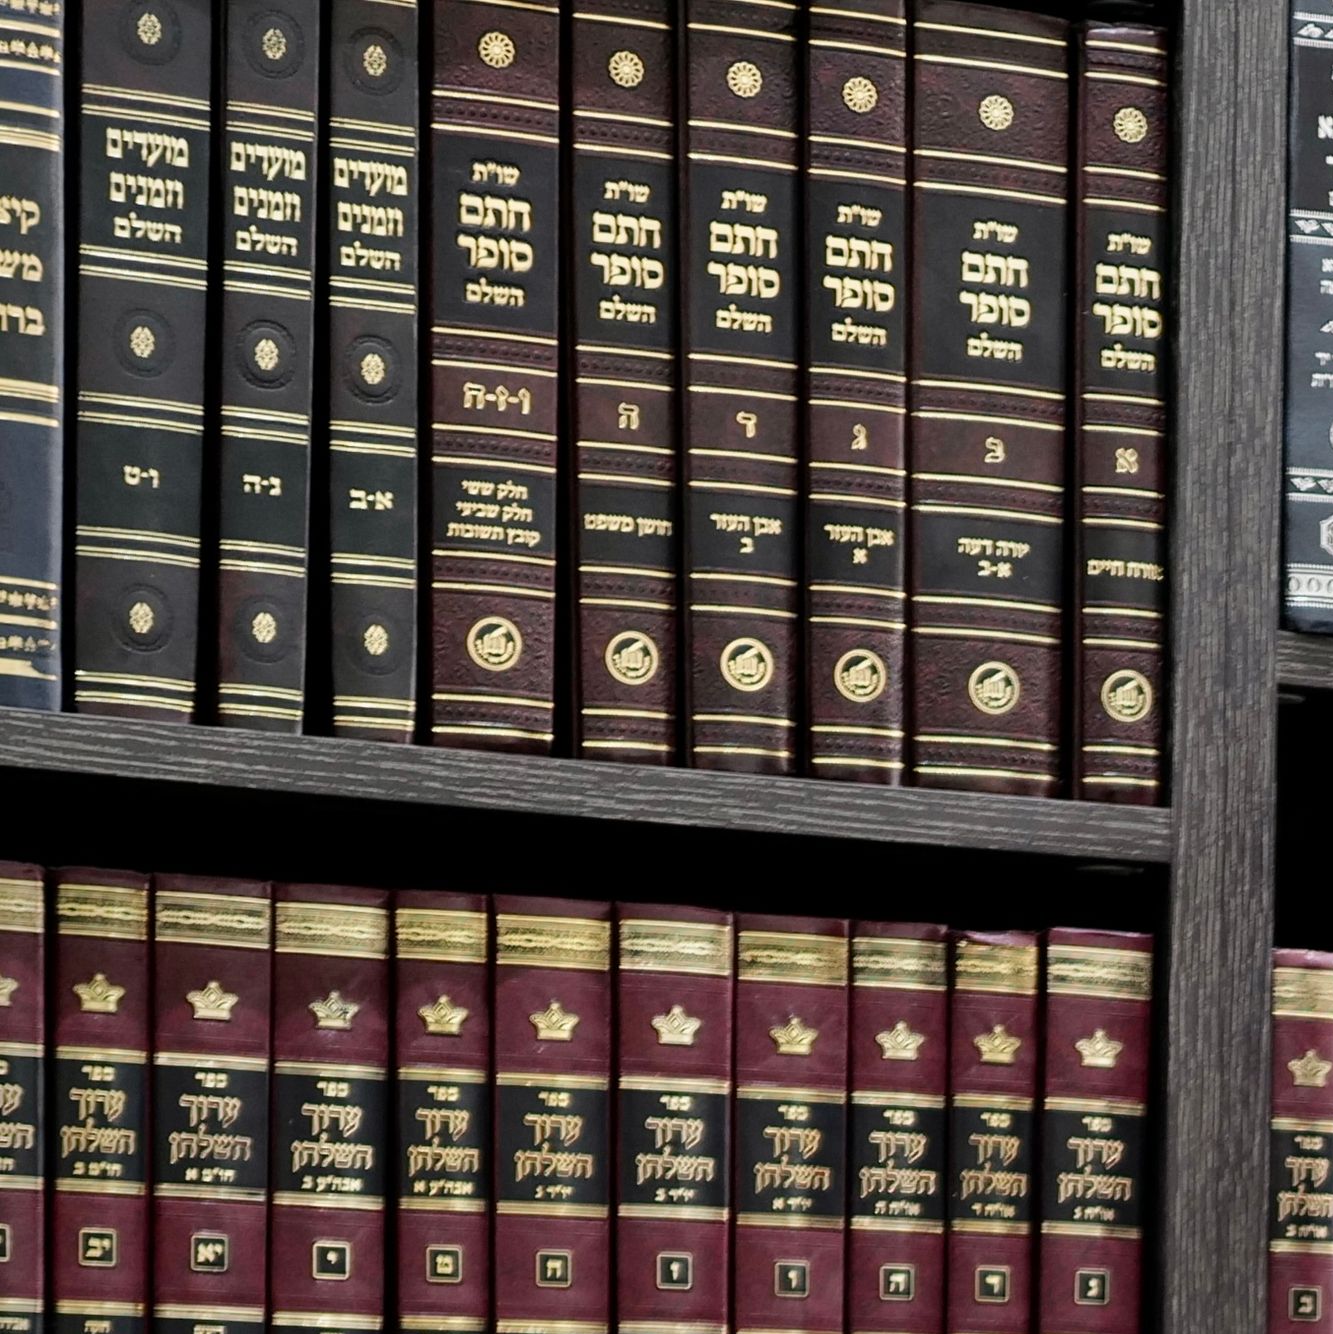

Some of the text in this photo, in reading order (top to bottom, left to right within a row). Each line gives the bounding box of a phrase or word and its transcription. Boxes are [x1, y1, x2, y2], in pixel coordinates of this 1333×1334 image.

[107, 128, 188, 167] מועדים
[231, 142, 305, 180] מועדים
[334, 158, 407, 196] מועדים
[473, 163, 519, 186] שו"ת
[605, 181, 650, 202] שו"ת
[722, 191, 767, 212] שו"ת
[461, 194, 530, 231] חתם
[838, 205, 882, 226] שו"ת
[114, 212, 182, 243] השלם
[236, 225, 297, 256] השלם
[593, 212, 660, 248] חתם
[710, 222, 777, 258] חתם
[973, 222, 1018, 243] שו"ת
[341, 241, 401, 270] השלם
[458, 235, 533, 272] סופר
[826, 236, 892, 271] חתם
[591, 253, 663, 288] סופר
[708, 262, 779, 298] סופר
[962, 252, 1028, 287] חתם
[1096, 264, 1159, 299] חתם
[467, 278, 524, 307] השלם
[824, 276, 894, 311] סופר
[600, 295, 655, 323] השלם
[717, 304, 772, 332] השלם
[960, 291, 1030, 326] סופר
[1093, 303, 1161, 338] סופר
[832, 318, 886, 345] השלם
[968, 333, 1022, 360] השלם
[1102, 344, 1154, 371] השלם
[736, 412, 756, 438] ד
[852, 424, 867, 449] ג
[1116, 448, 1138, 473] א
[350, 490, 393, 510] א-ב
[462, 481, 528, 499] חלק ששי
[502, 503, 532, 522] חלק
[585, 514, 634, 532] משפט
[710, 514, 781, 536] אבן העזר
[447, 523, 504, 540] תשובות
[740, 537, 753, 553] ב
[854, 549, 867, 563] א
[958, 538, 1030, 558] יורה דעה
[978, 560, 1011, 577] א-ב
[82, 1066, 115, 1081] ספר
[195, 1073, 227, 1088] ספר
[70, 1088, 126, 1122] ערוך
[179, 1094, 242, 1128] ערוך
[61, 1117, 135, 1157] השלחן
[169, 1123, 252, 1164] השלחן
[1067, 1137, 1124, 1169] ערוך
[1058, 1164, 1131, 1203] השלחן
